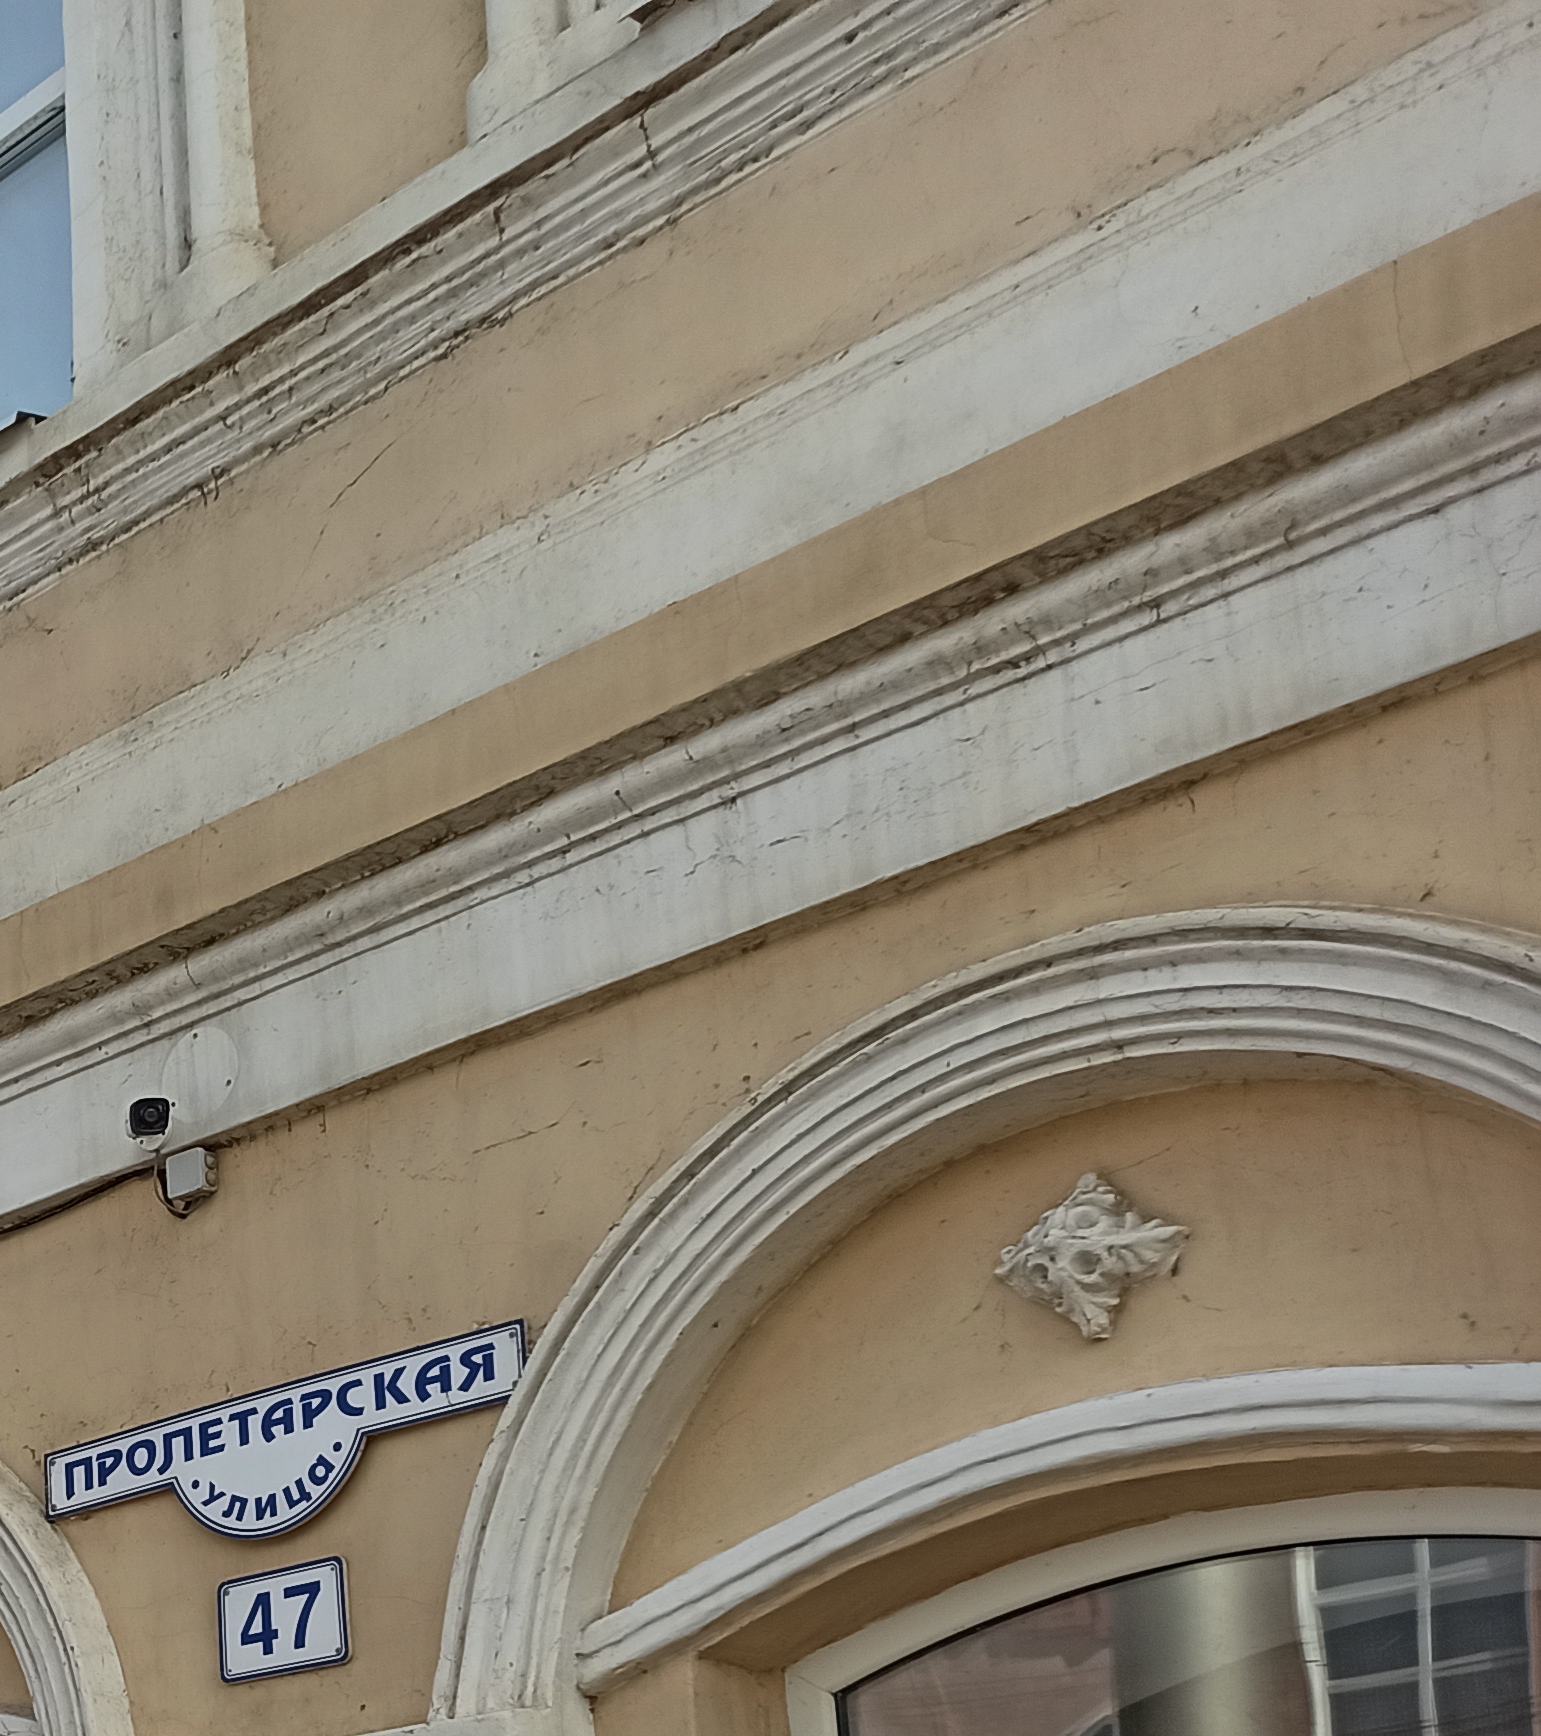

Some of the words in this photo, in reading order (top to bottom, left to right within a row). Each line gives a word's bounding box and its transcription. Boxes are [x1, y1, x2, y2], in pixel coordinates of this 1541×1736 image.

[63, 1342, 496, 1501] ПРОЛЕТАРСКАЯ
[199, 1453, 336, 1523] улица
[239, 1579, 322, 1657] 47
